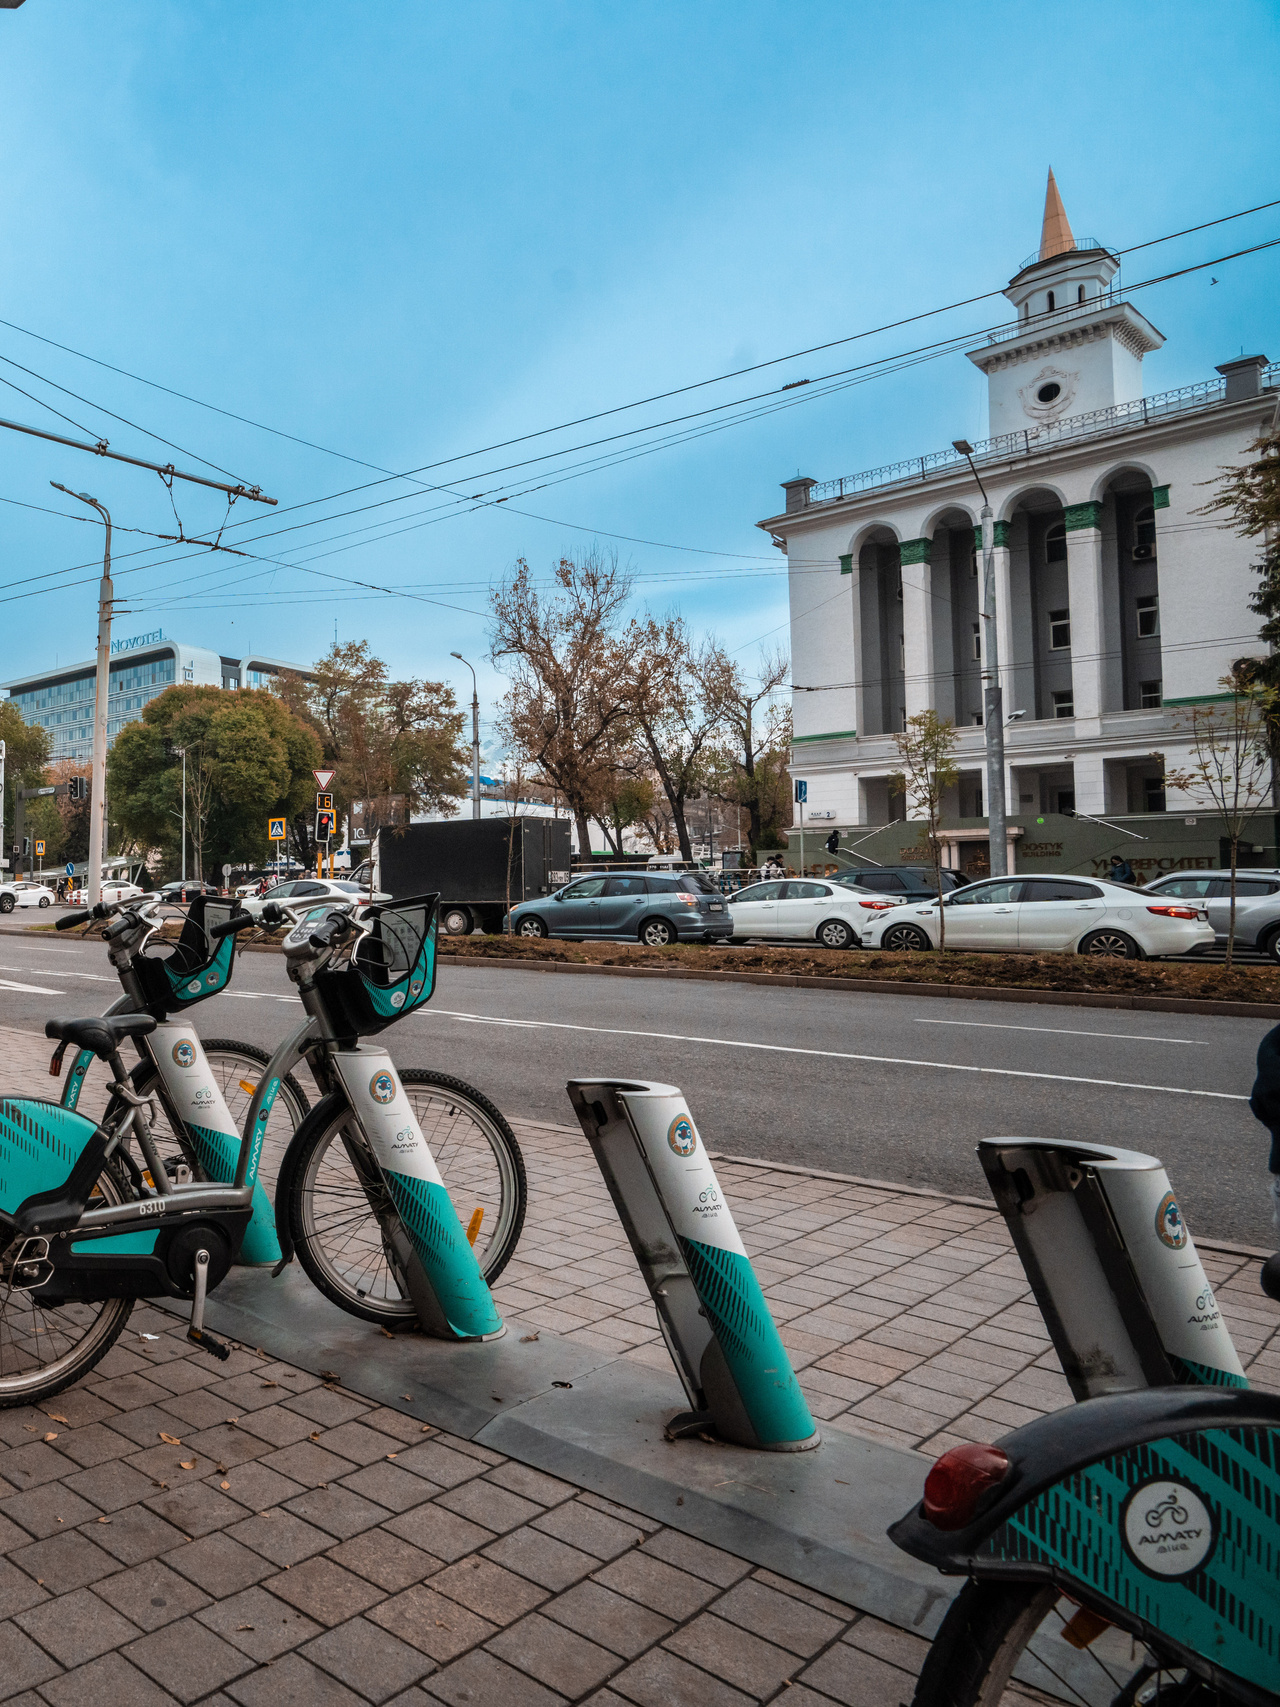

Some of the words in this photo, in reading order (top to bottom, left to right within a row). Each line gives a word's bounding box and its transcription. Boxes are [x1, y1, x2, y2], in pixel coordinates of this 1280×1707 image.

[111, 628, 167, 654] NOVOTEL
[318, 796, 330, 808] 16
[1022, 850, 1061, 858] BUILDING
[1091, 857, 1216, 871] УНВЕРСИТЕТ
[249, 1128, 262, 1180] ALMATY
[140, 1200, 166, 1215] 6310
[692, 1203, 722, 1213] ALMATY
[1138, 1529, 1203, 1546] ALMATY
[1156, 1543, 1190, 1554] BIKE
